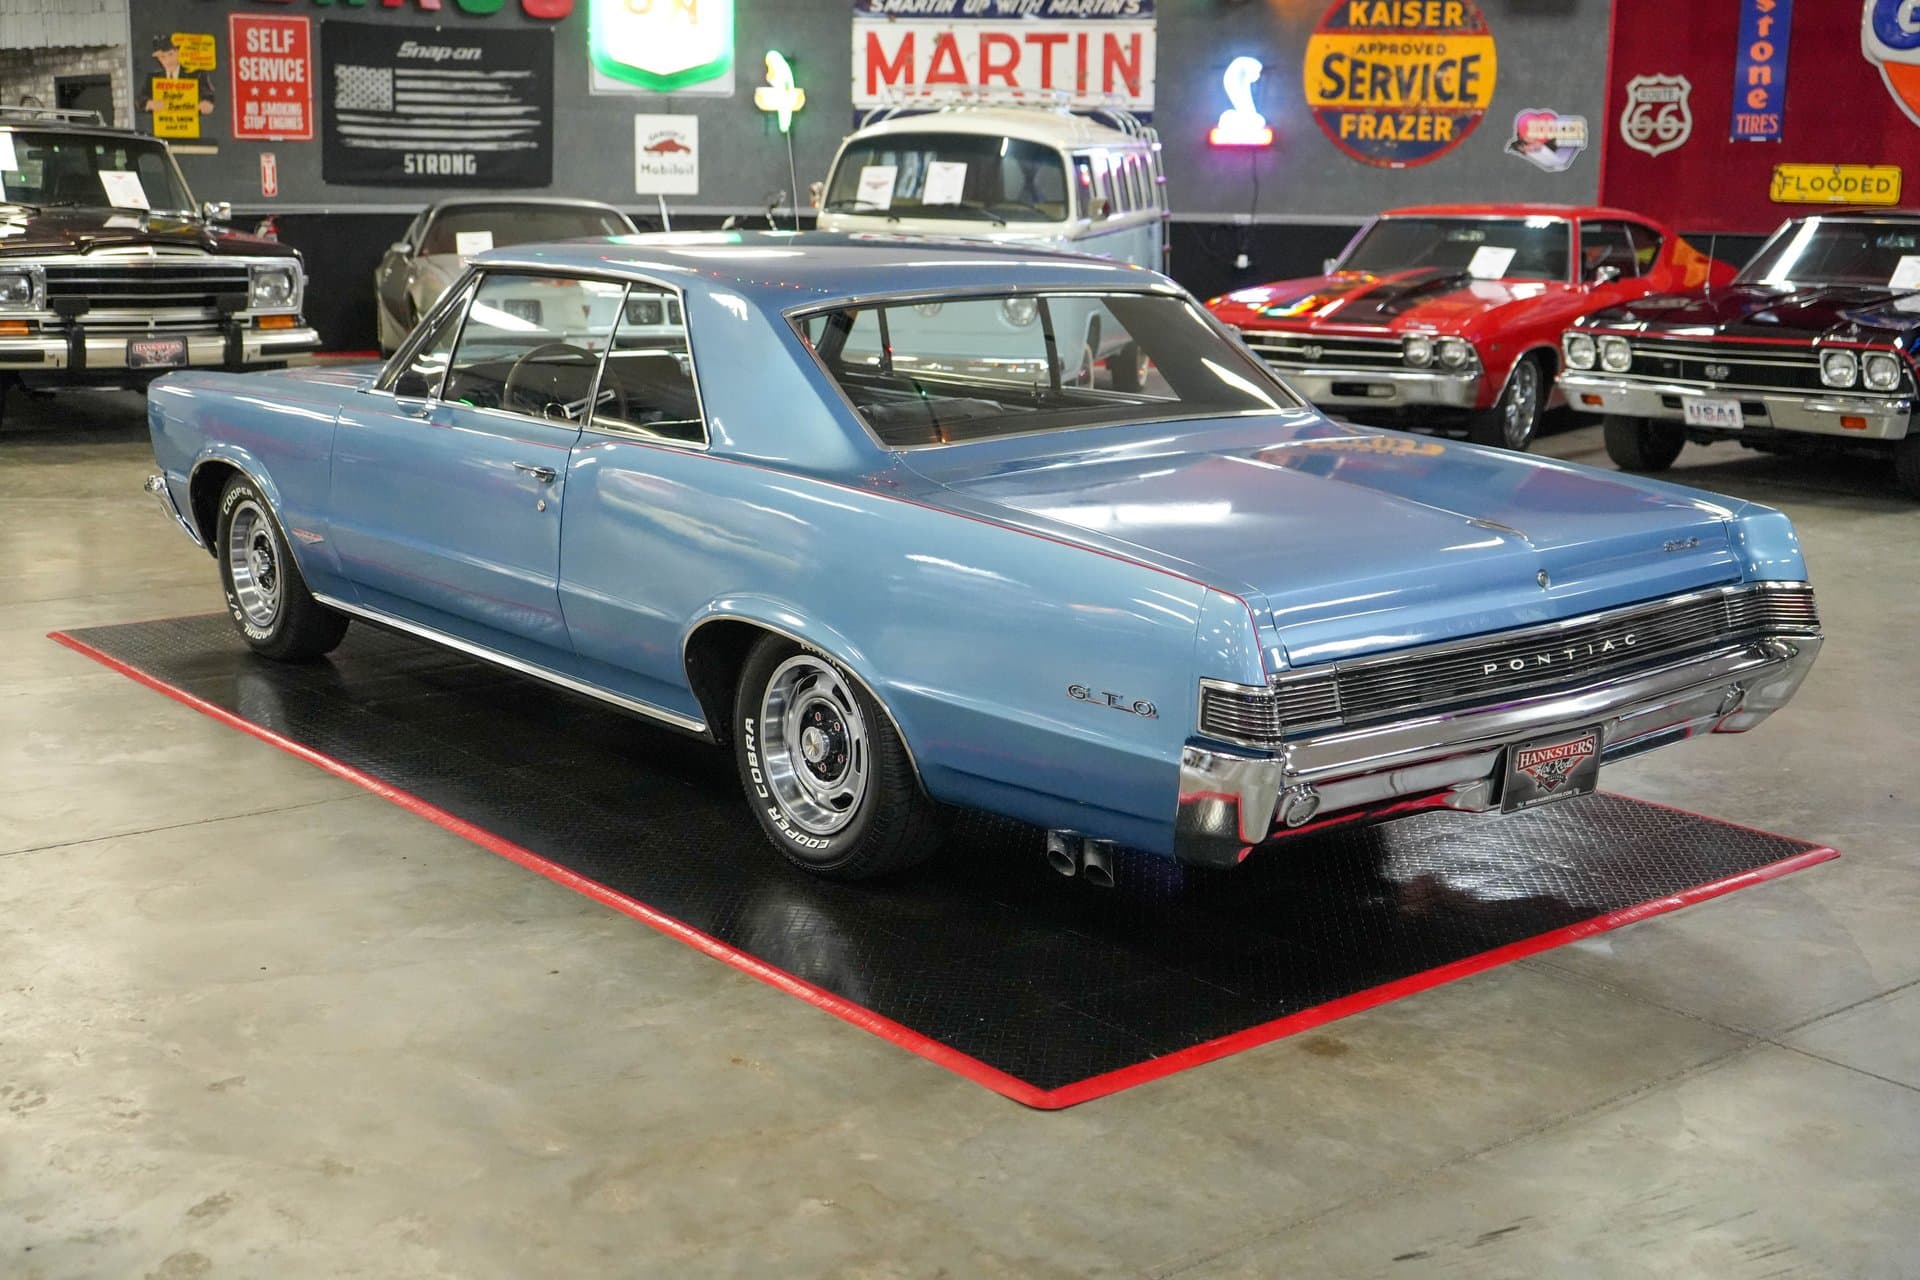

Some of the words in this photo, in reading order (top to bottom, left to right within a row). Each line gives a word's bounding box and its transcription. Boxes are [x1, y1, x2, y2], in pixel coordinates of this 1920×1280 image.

[1348, 0, 1465, 27] KAISER
[246, 27, 295, 54] SELF
[397, 41, 482, 62] Snap-on
[1356, 43, 1447, 56] APPROVED
[239, 57, 305, 83] SERVICE
[866, 31, 1141, 98] MARTIN
[1319, 52, 1481, 103] SERVICE
[1639, 87, 1680, 101] ROUTE
[245, 101, 259, 115] NO
[261, 102, 302, 116] SMOKING
[1631, 103, 1679, 141] 66
[244, 115, 266, 130] STOP
[268, 116, 304, 131] ENGINES
[1340, 113, 1454, 142] FRAZER
[1736, 114, 1779, 134] TIRES
[404, 154, 477, 175] STRONG
[1781, 175, 1892, 193] FLOODED
[223, 486, 254, 516] COOPER
[244, 621, 274, 640] RADIAL
[1483, 634, 1637, 676] PONTIAC
[1067, 684, 1157, 718] GTO
[744, 718, 770, 799] COBRA
[1520, 738, 1594, 768] HANKSTERS
[767, 806, 830, 850] COOPER
